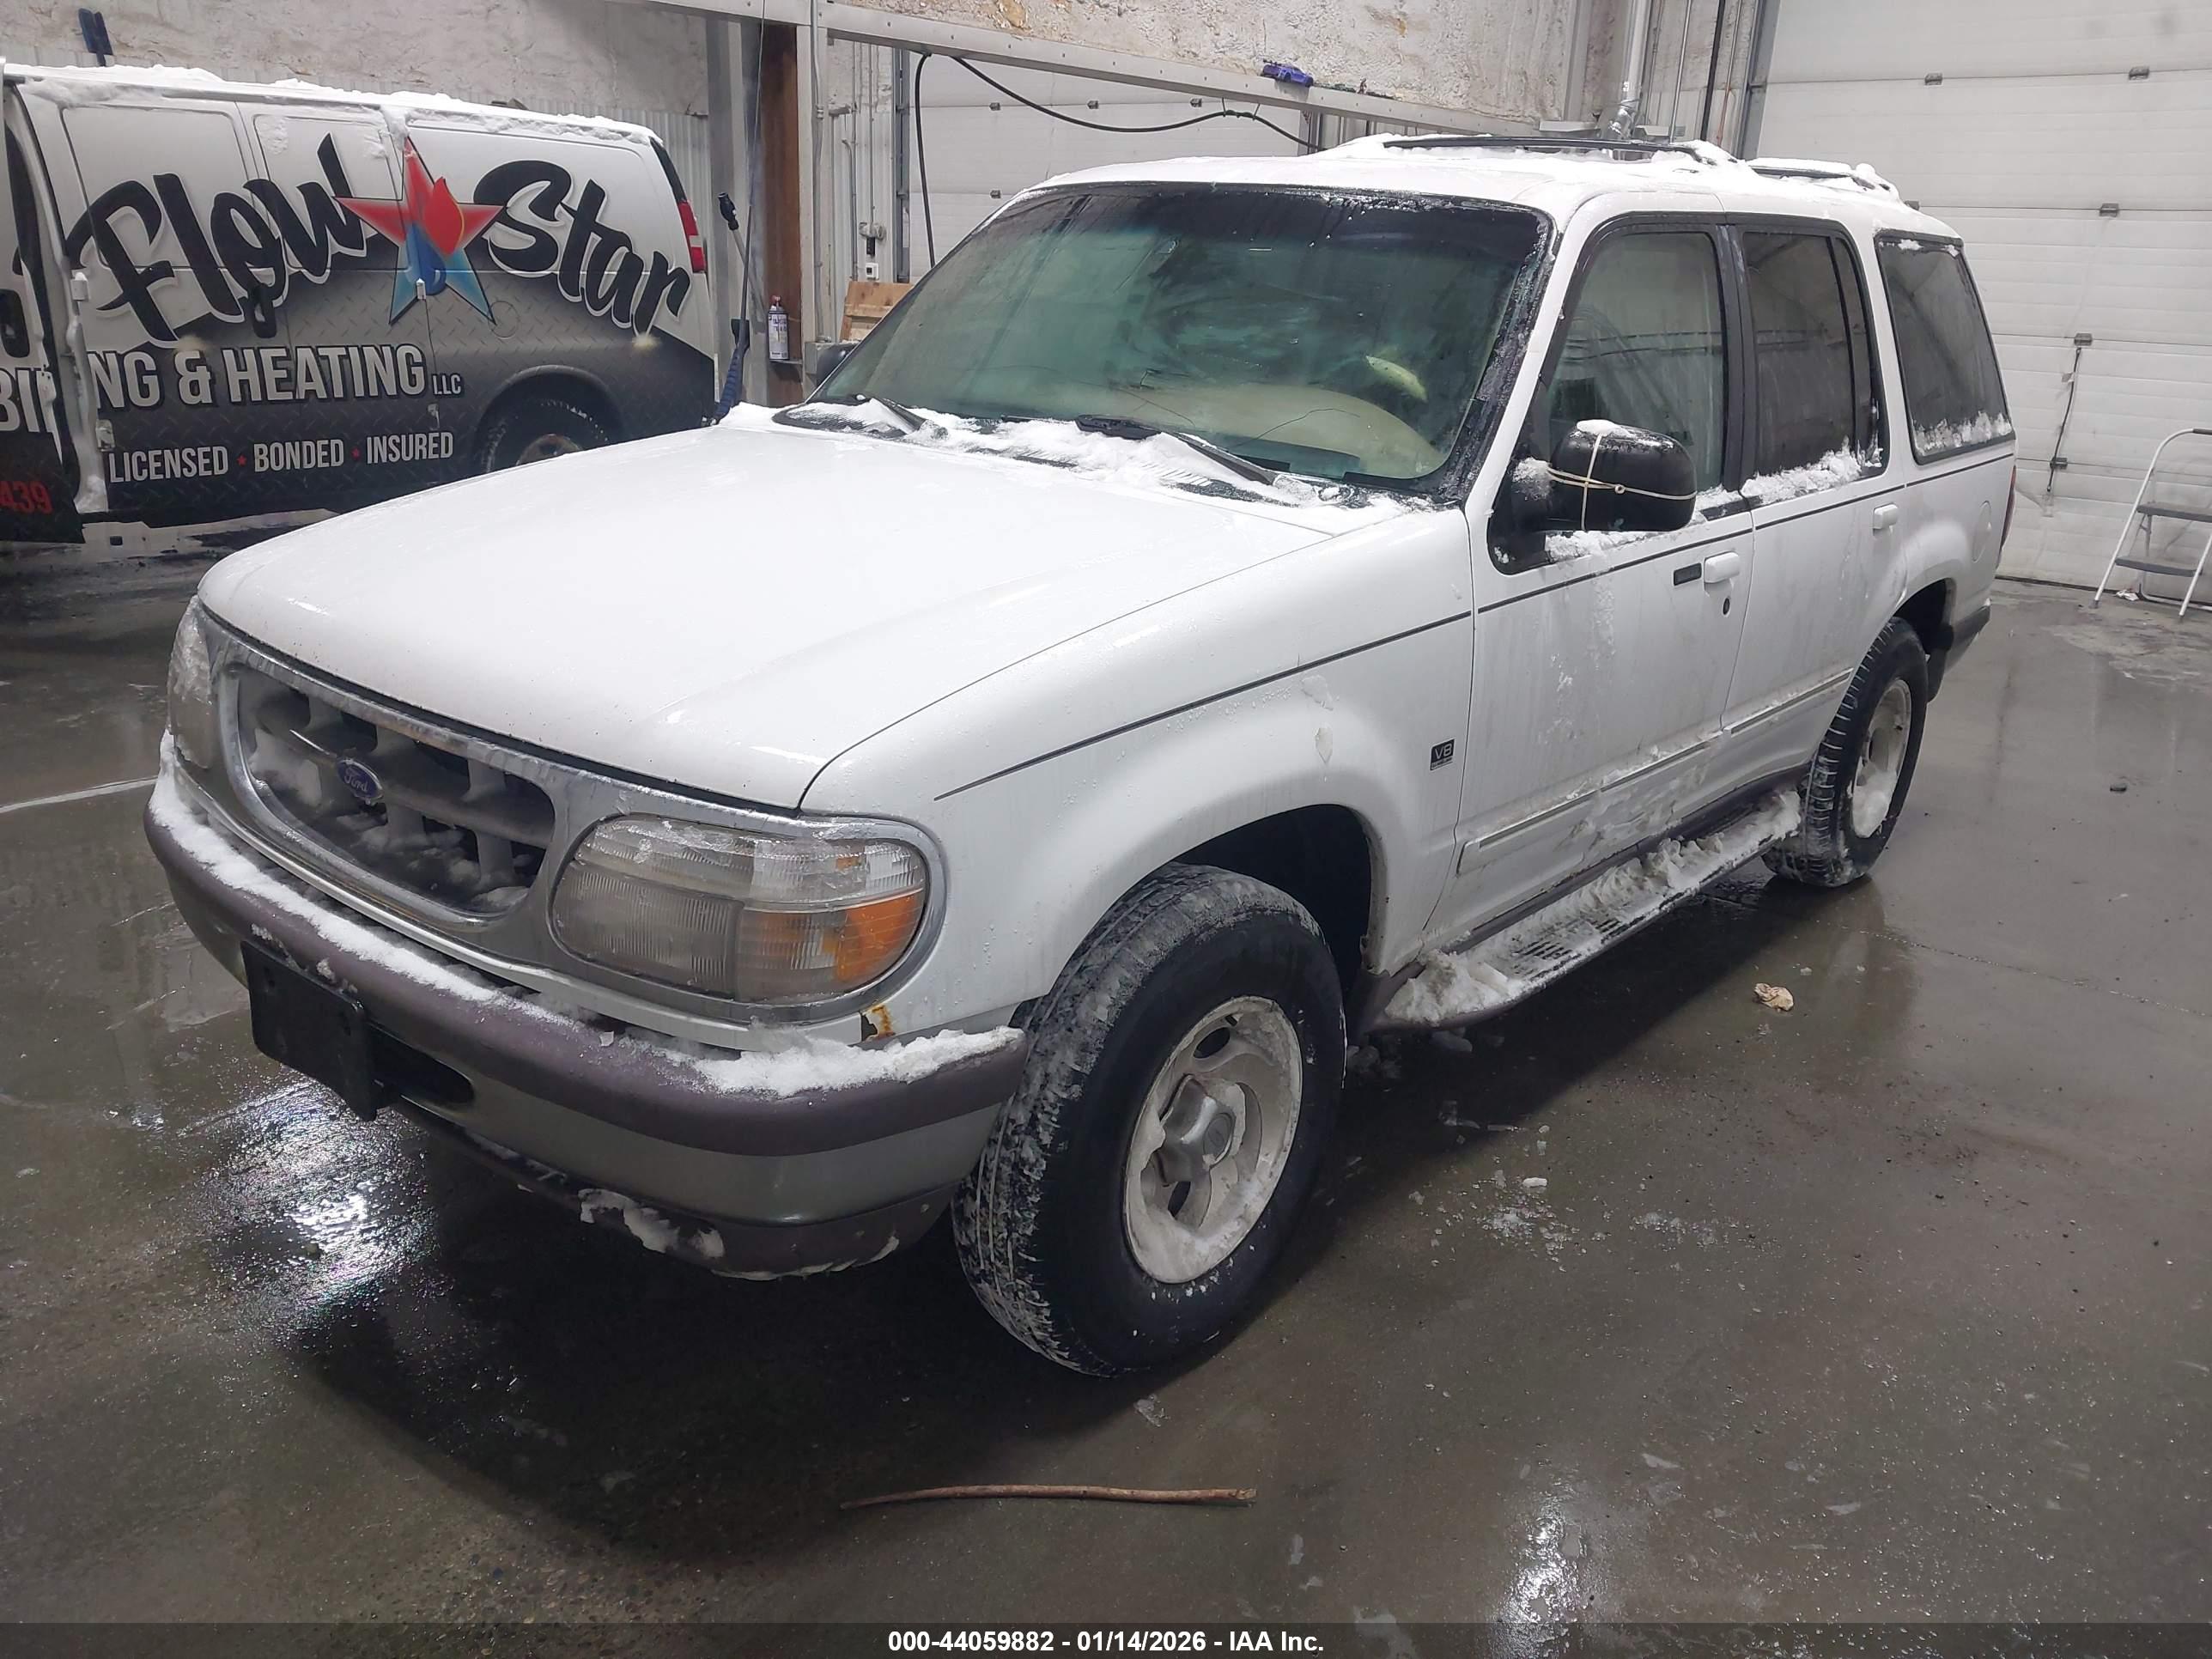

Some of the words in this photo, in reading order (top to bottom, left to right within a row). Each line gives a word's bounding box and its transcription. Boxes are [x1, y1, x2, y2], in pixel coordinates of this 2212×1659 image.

[64, 131, 367, 341] Flow
[472, 159, 690, 336] Star
[174, 349, 213, 404] &
[222, 345, 425, 403] HEATING
[433, 374, 461, 395] LLC
[108, 446, 228, 483] LICENSED
[253, 439, 343, 472] BONDED
[367, 432, 453, 465] INSURED
[1434, 743, 1452, 759] V8
[343, 766, 368, 793] Ford
